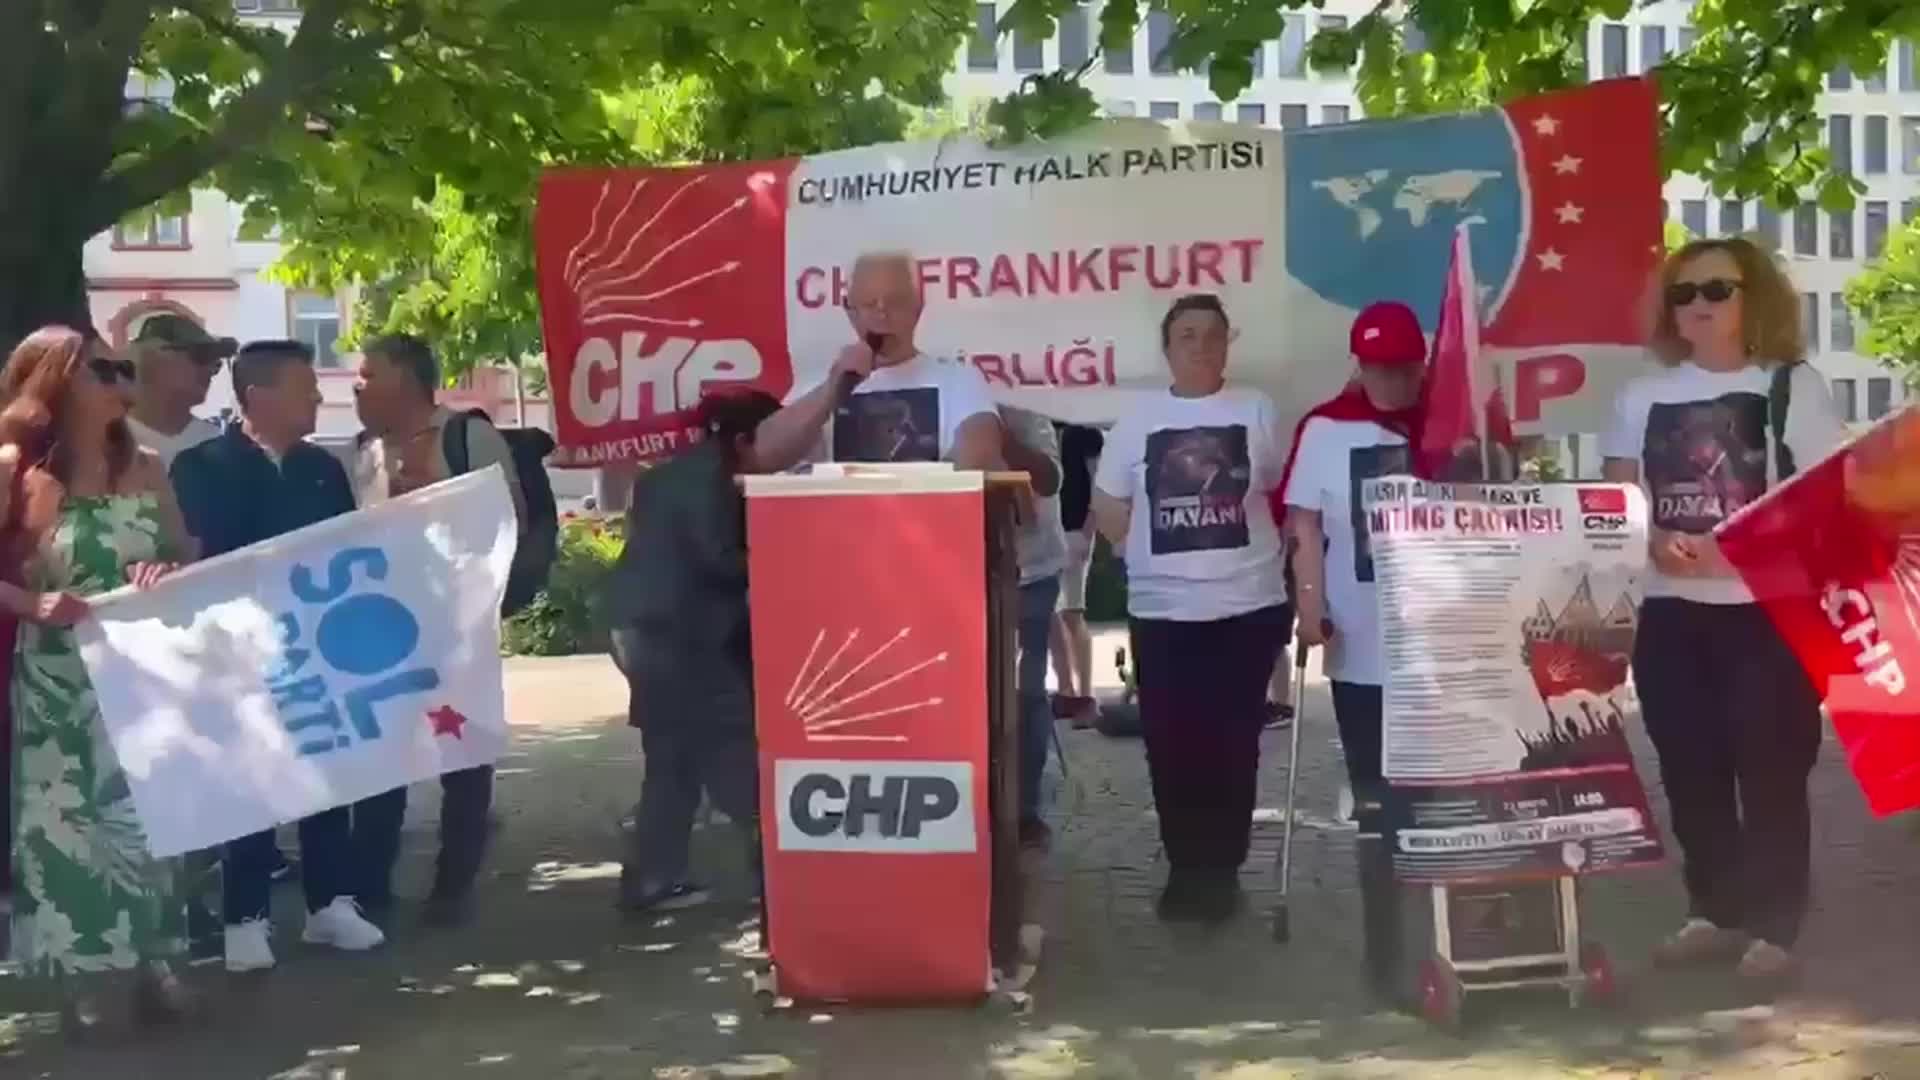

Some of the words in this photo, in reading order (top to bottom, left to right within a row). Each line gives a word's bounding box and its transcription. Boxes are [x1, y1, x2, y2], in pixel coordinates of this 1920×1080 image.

[1013, 153, 1112, 185] HALK
[916, 238, 1265, 302] FRANKFURT
[569, 331, 763, 427] CHP
[937, 336, 1117, 389] RLİĞİ
[288, 546, 440, 740] SOL
[1820, 580, 1906, 696] CHP
[788, 772, 960, 840] CHP
